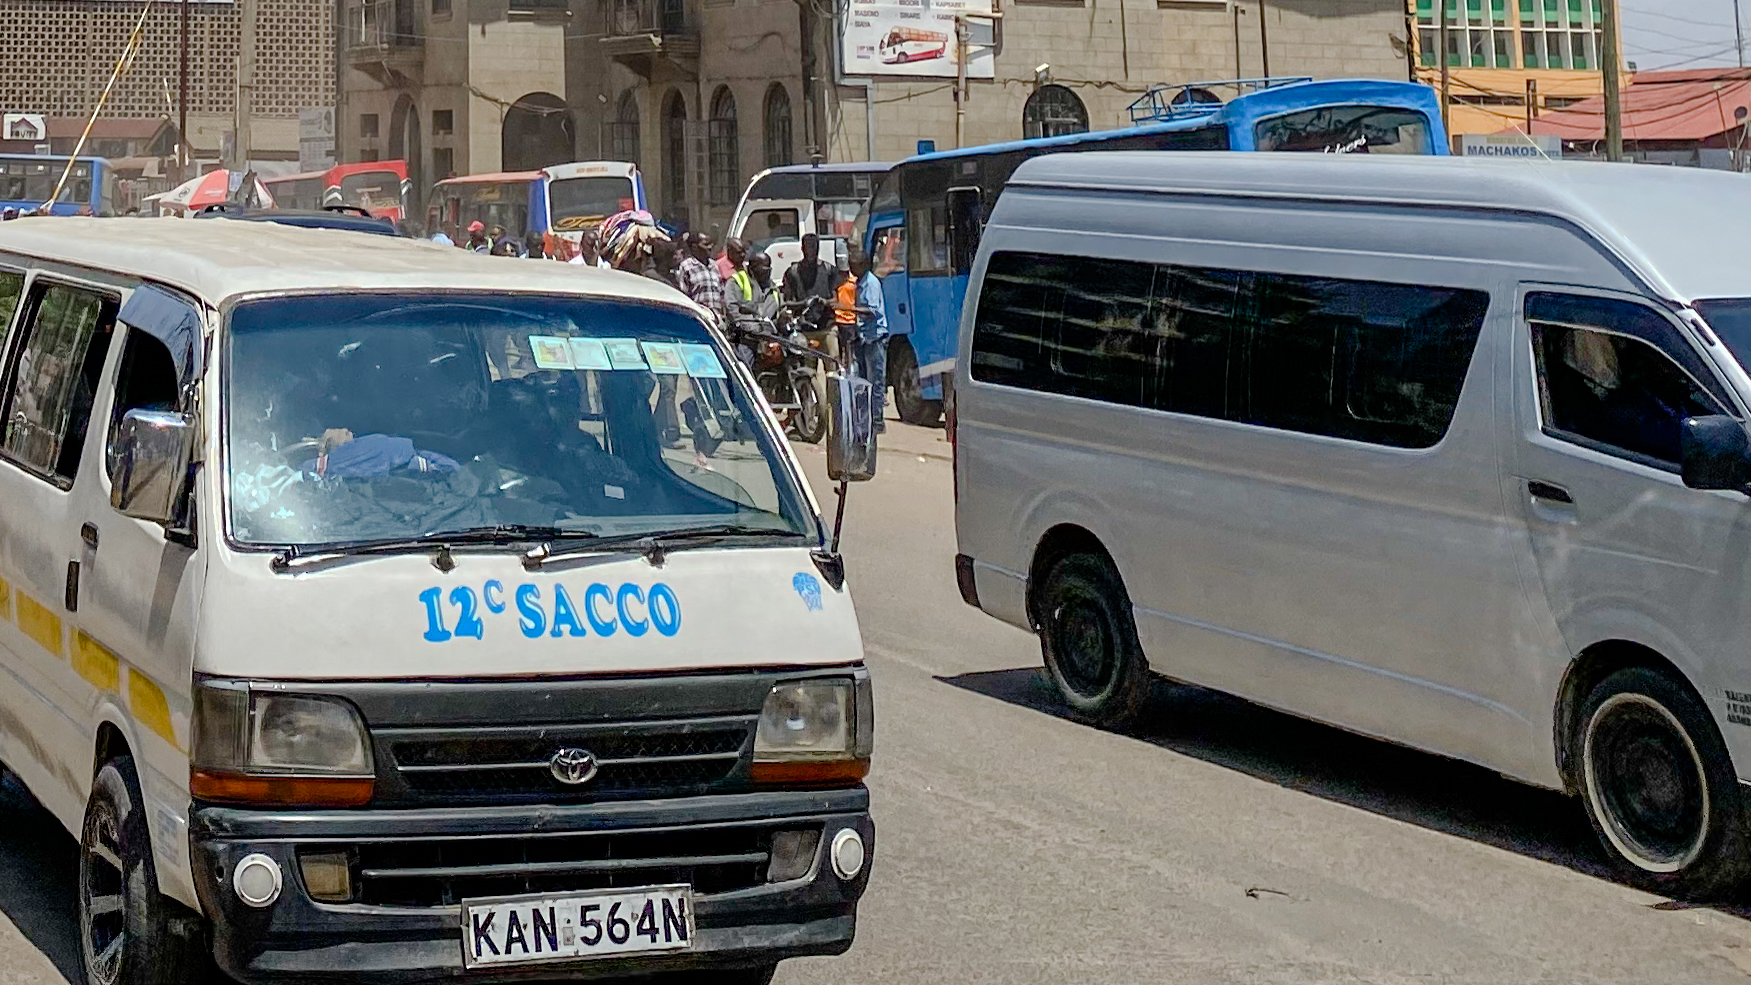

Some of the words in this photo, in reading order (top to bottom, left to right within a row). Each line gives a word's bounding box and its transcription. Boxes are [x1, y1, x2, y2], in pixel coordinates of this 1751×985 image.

[1467, 145, 1538, 157] MACHAKOS
[515, 582, 682, 639] SACCO
[472, 906, 559, 958] KAN
[579, 897, 689, 947] 564N
